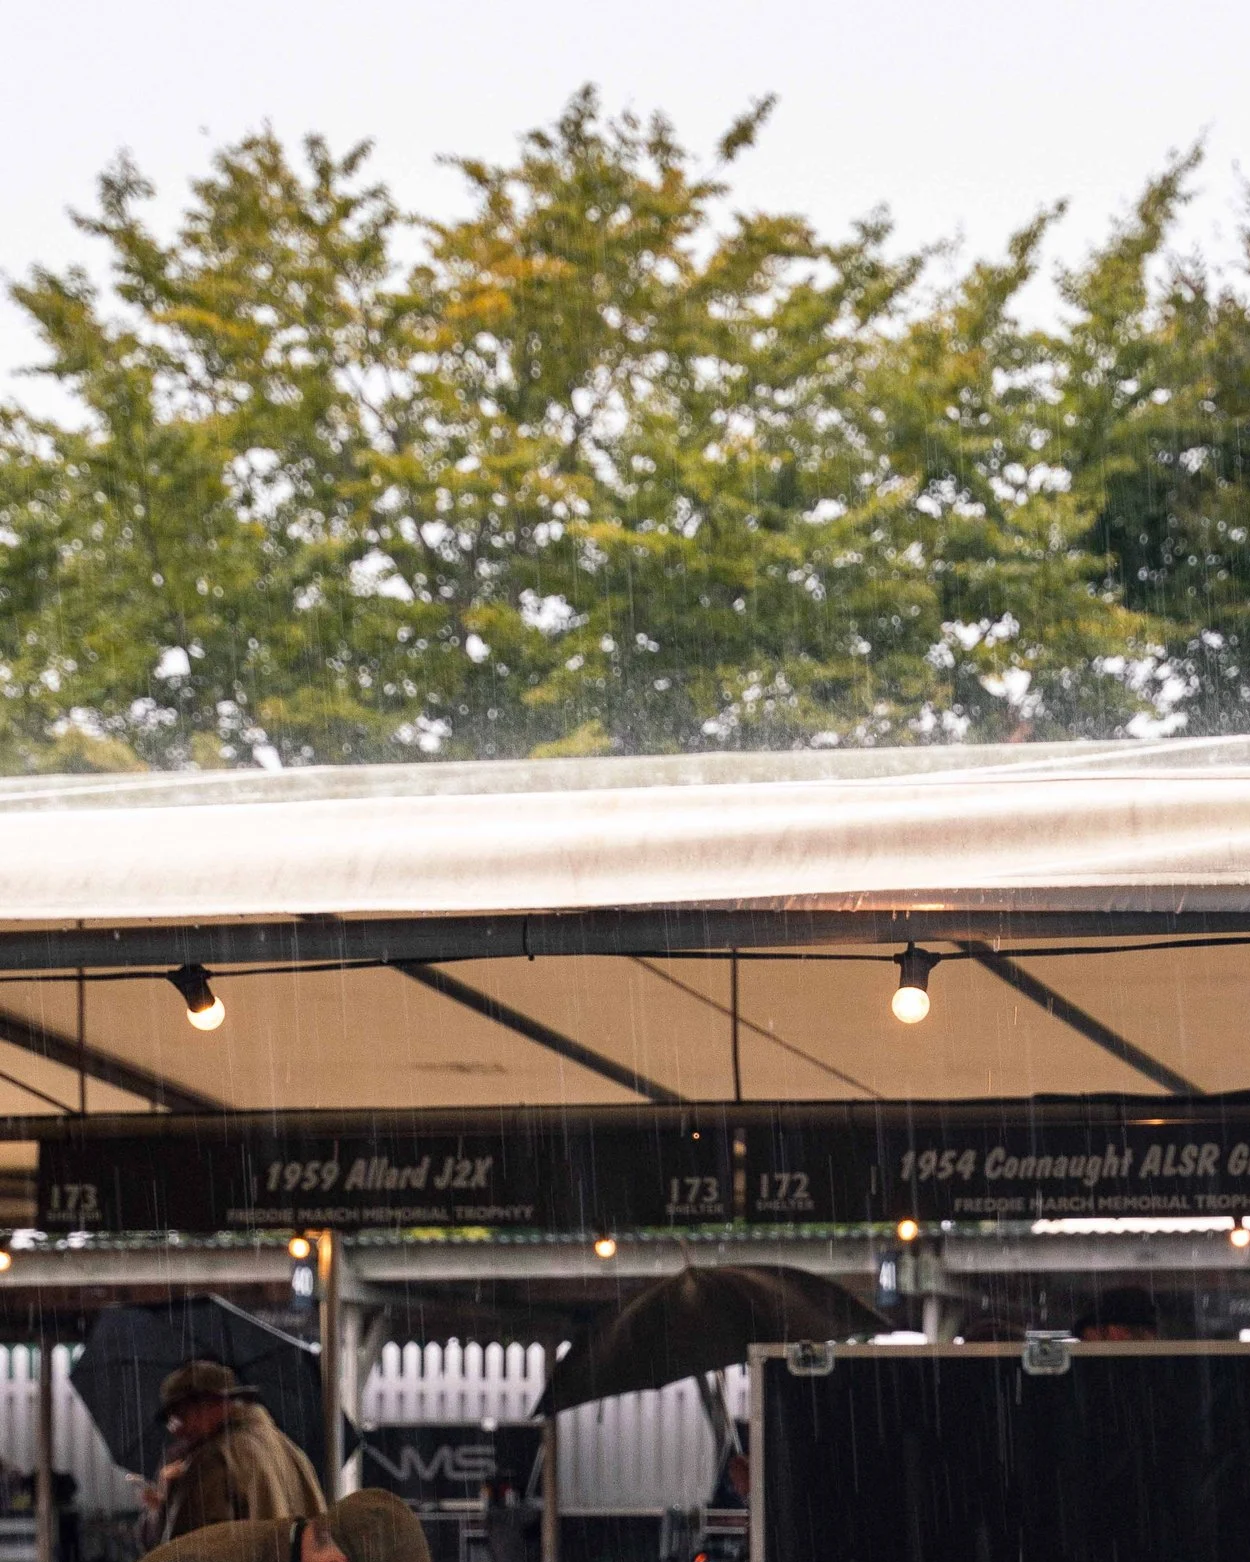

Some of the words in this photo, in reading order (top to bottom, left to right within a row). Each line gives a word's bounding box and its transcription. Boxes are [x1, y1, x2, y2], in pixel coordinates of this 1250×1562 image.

[267, 1160, 340, 1191] 1959
[344, 1155, 431, 1191] Allard
[434, 1155, 494, 1190] J2X
[900, 1149, 976, 1181] 1954
[984, 1146, 1134, 1188] Connaught
[1139, 1143, 1220, 1178] ALSR
[51, 1183, 98, 1211] 173
[670, 1177, 719, 1203] 173
[760, 1171, 810, 1199] 172
[954, 1196, 1025, 1212] FREDDIE
[1029, 1195, 1094, 1211] MARCH
[1098, 1194, 1190, 1210] MEMORIAL
